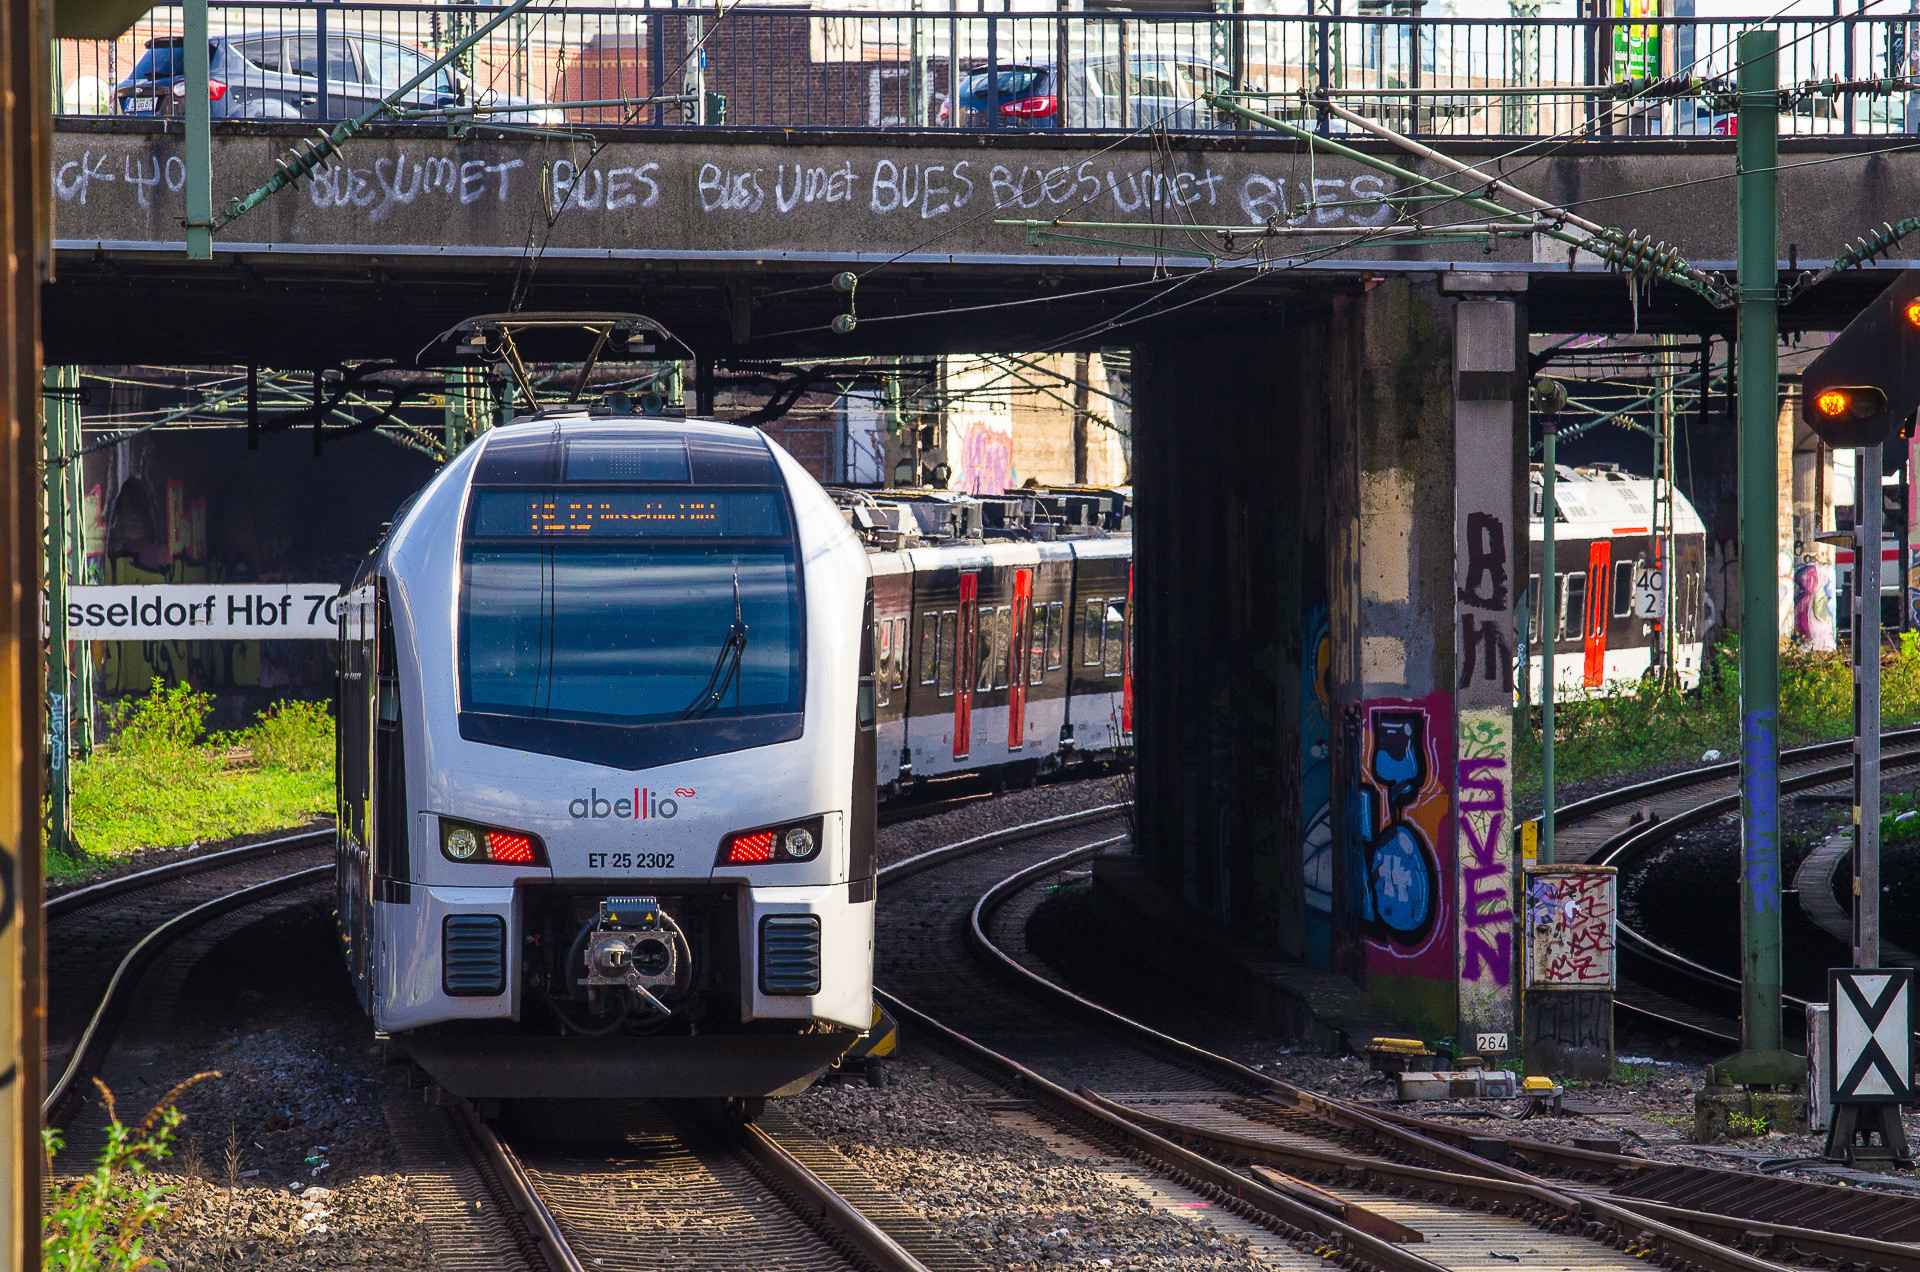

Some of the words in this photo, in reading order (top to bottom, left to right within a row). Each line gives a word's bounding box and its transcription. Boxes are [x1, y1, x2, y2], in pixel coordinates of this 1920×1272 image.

[552, 159, 660, 212] BUES
[868, 159, 974, 219] BUES
[989, 160, 1101, 209] BUES
[46, 594, 216, 628] sseldorf
[227, 594, 292, 626] Hbf
[1644, 594, 1656, 613] 2
[568, 787, 679, 820] abellio
[588, 853, 608, 868] ET
[612, 853, 632, 868] 25
[636, 853, 675, 868] 2302
[1478, 1035, 1507, 1050] 264
